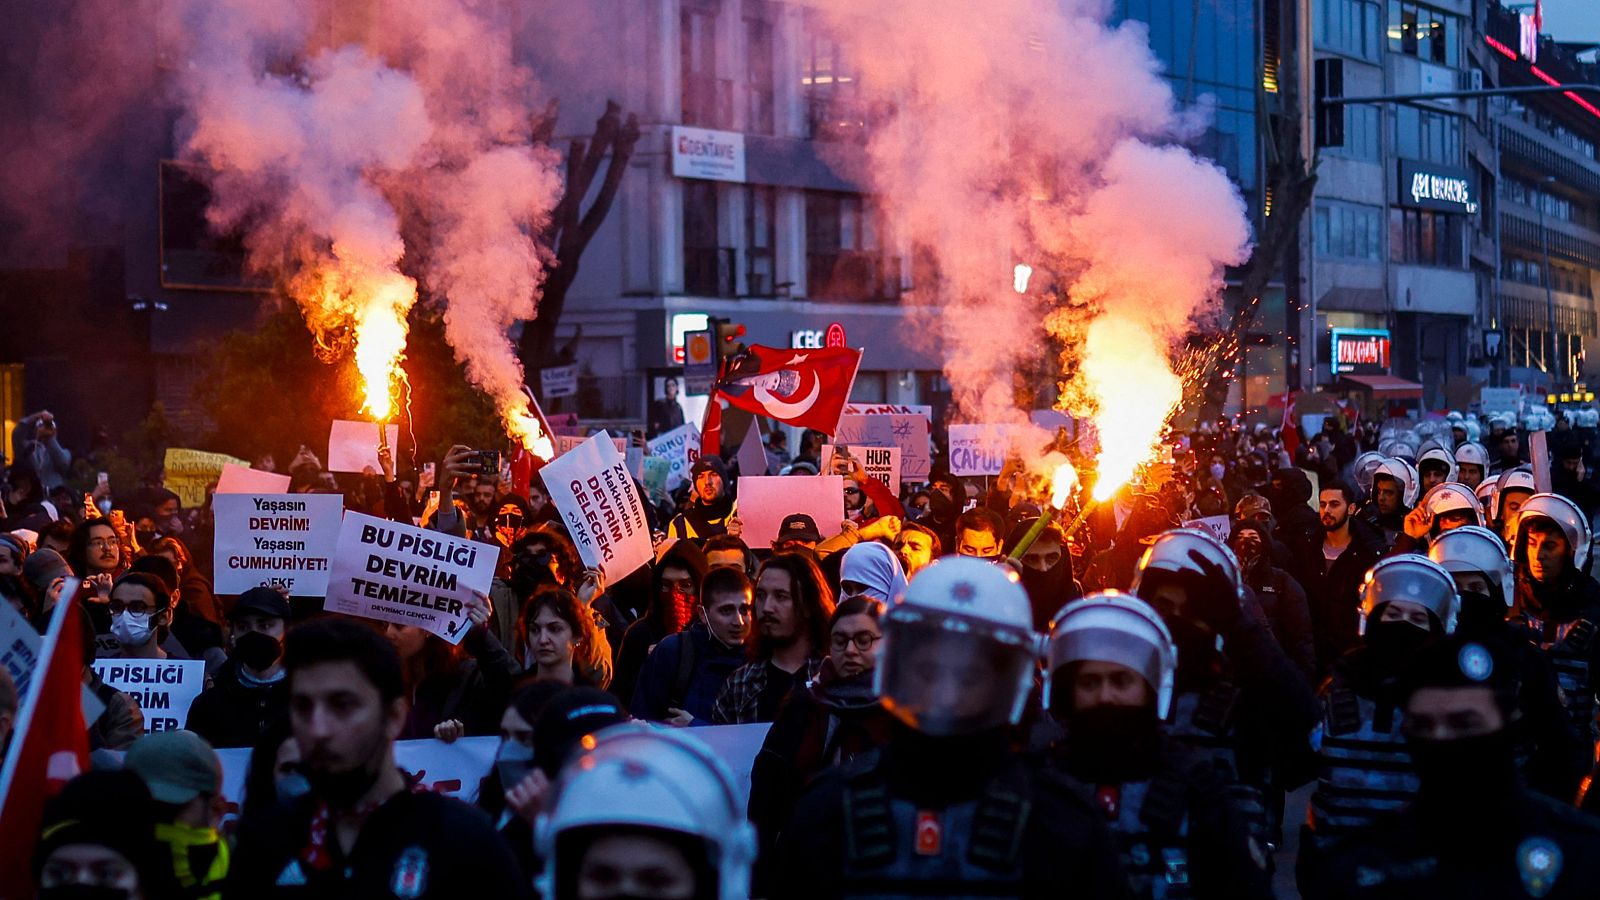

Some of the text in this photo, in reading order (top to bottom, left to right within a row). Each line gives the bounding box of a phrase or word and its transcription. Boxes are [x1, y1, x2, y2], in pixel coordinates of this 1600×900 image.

[792, 330, 824, 349] ICBC
[866, 450, 891, 465] HÜR
[867, 473, 890, 488] ÜR
[602, 469, 634, 537] Hakkından
[613, 462, 643, 529] Zorbaların
[253, 498, 306, 514] Yaşasın
[586, 475, 624, 544] DEVRİM
[249, 515, 310, 531] DEVRİM!
[570, 479, 614, 563] GELECEK!
[574, 522, 592, 546] FKF
[253, 537, 305, 553] Yaşasın
[360, 524, 477, 568] BU PİSLİĞİ
[228, 554, 328, 571] CUMHURİYET!
[366, 554, 457, 591] DEVRİM
[272, 577, 294, 588] FKF
[351, 578, 464, 617] TEMİZLER
[371, 604, 406, 616] DEVRİMCİ
[406, 611, 437, 622] GENÇLİK
[109, 664, 184, 684] PİSLİĞİ
[125, 688, 170, 709] RİM
